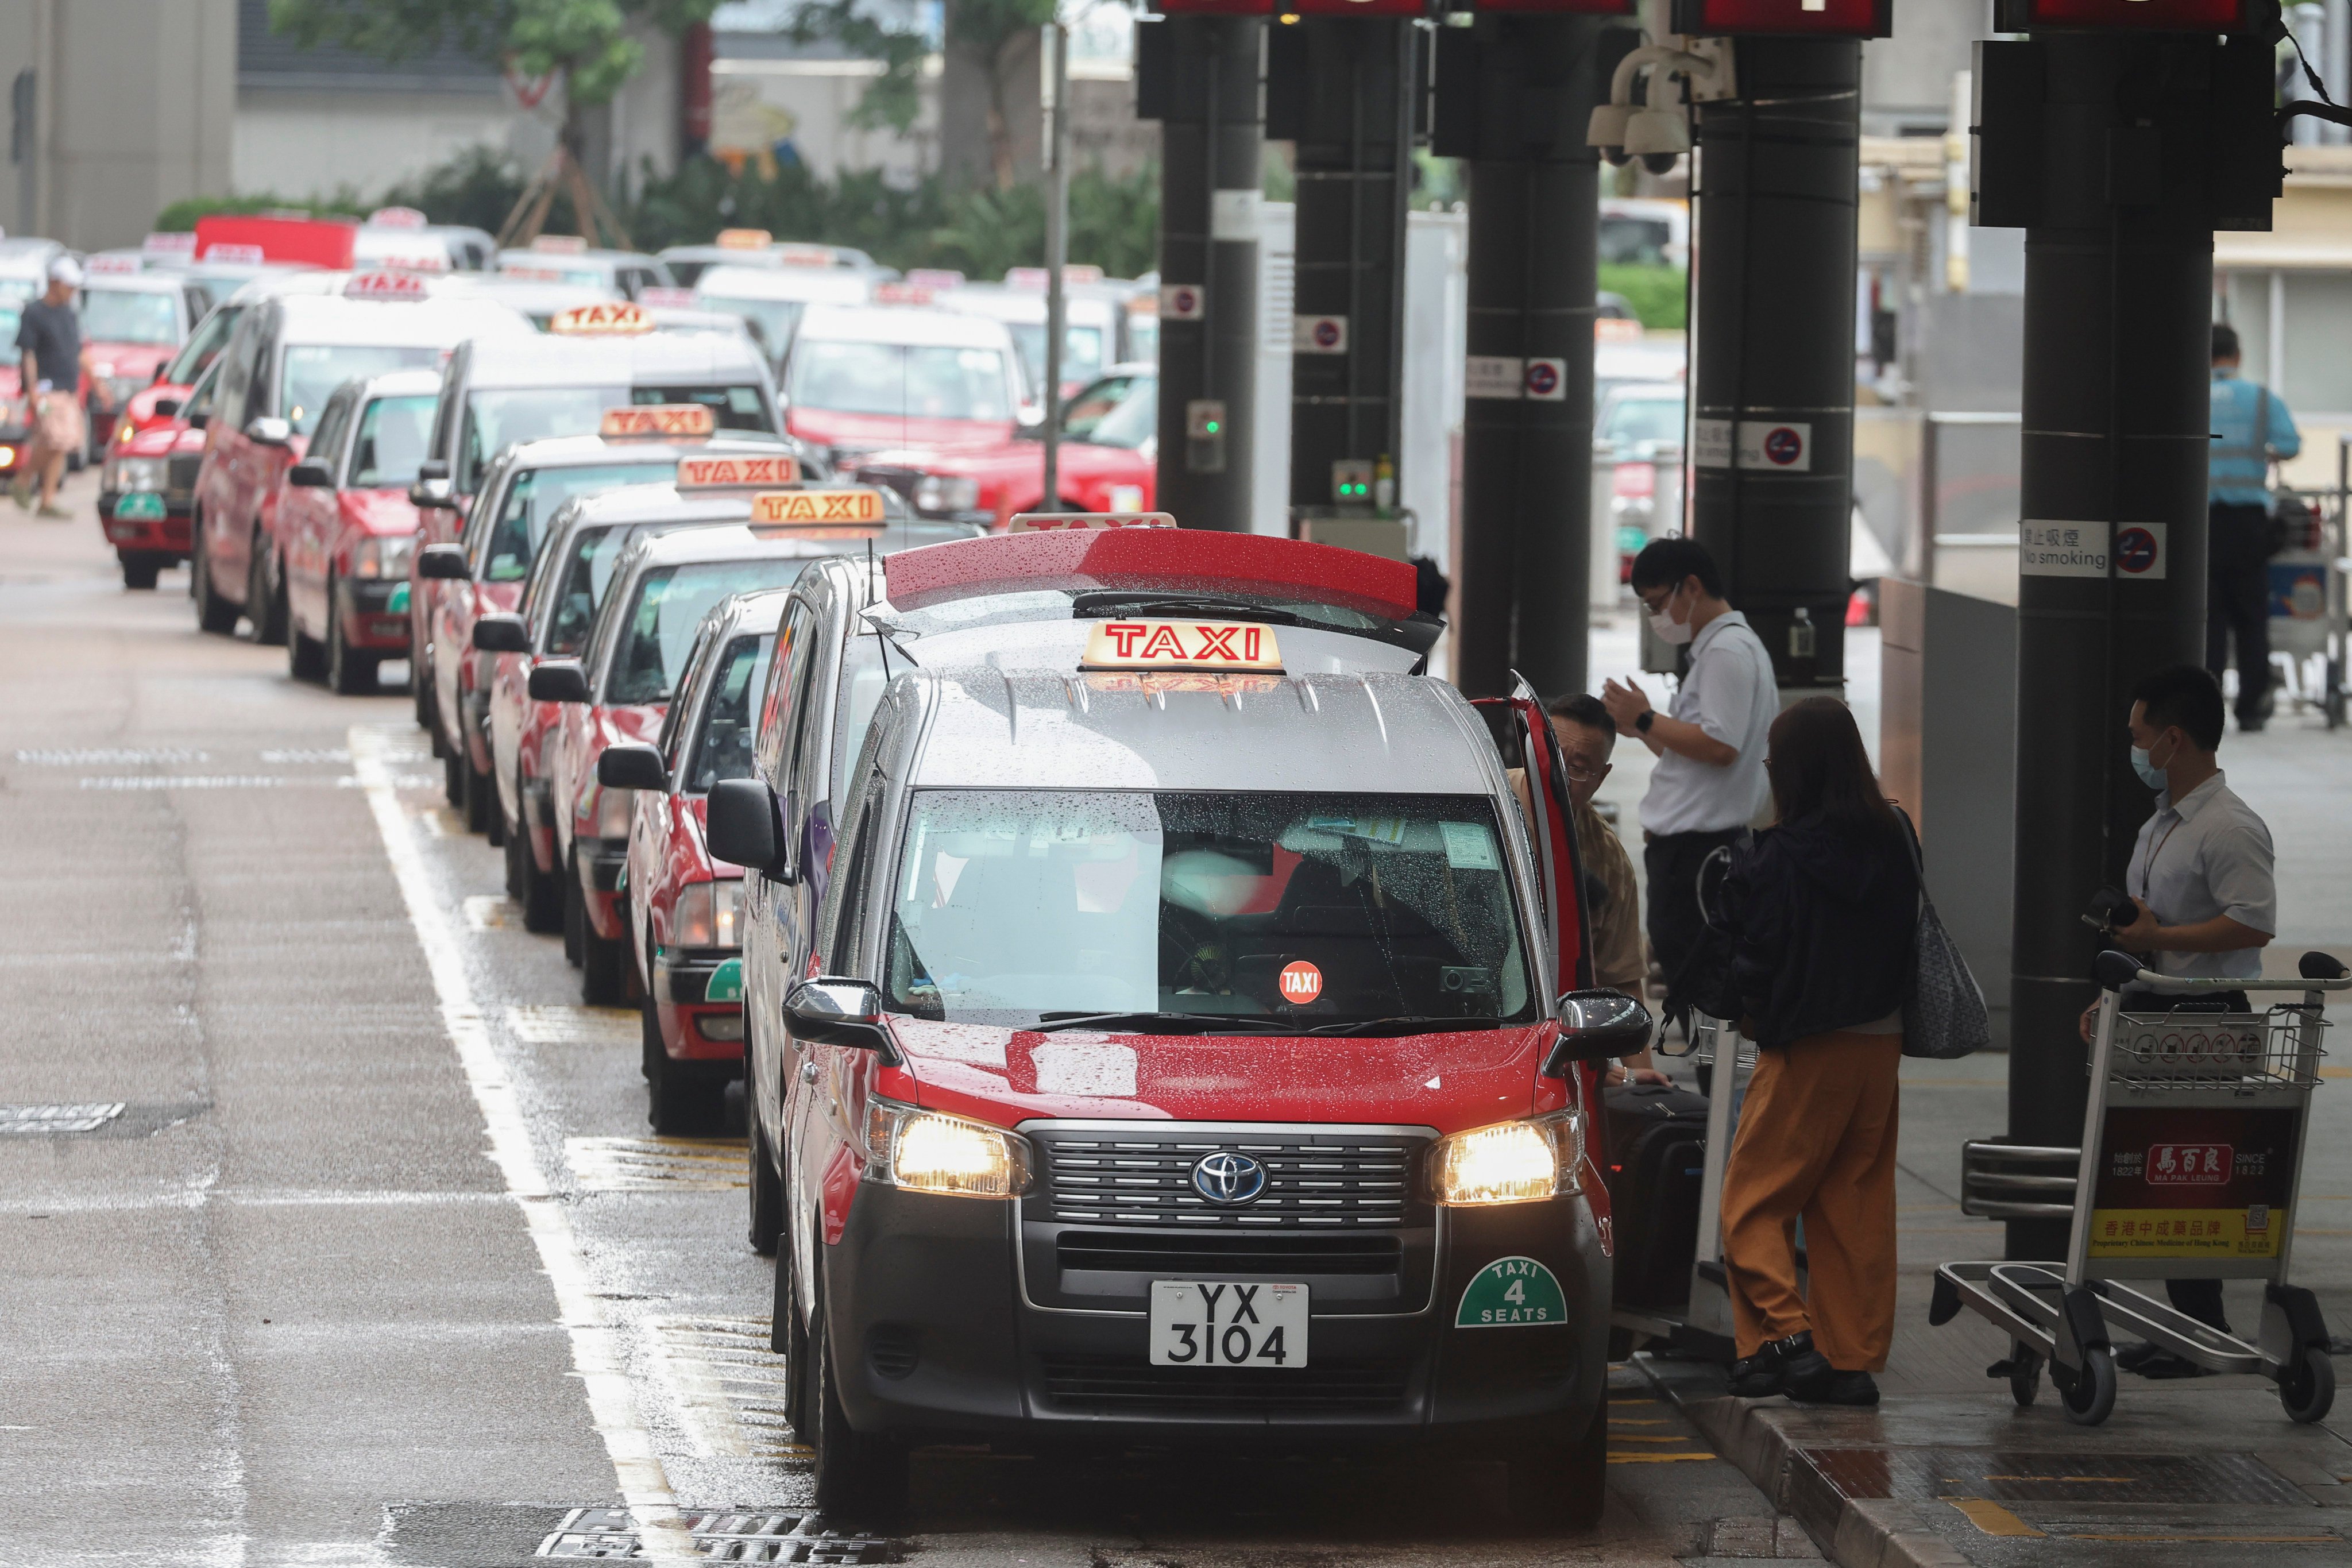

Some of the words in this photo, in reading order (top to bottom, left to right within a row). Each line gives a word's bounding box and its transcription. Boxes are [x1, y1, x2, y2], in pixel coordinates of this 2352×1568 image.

[357, 272, 420, 291] TAXI
[568, 304, 641, 323] TAXI
[611, 411, 702, 431] TAXI
[686, 459, 791, 483] TAXI
[762, 495, 872, 519] TAXI
[2025, 529, 2079, 546] 禁止吸煙
[2025, 549, 2036, 563] No
[2040, 550, 2106, 569] smoking
[1106, 624, 1260, 661] TAXI
[1283, 972, 1318, 992] TAXI
[2114, 1152, 2143, 1164] 始創於
[2157, 1146, 2220, 1173] 馬百良
[2235, 1154, 2265, 1164] SINCE
[2112, 1167, 2142, 1176] 1822年
[2235, 1166, 2264, 1175] 1822
[2105, 1220, 2221, 1236] 香港中成藥品牌
[2092, 1240, 2128, 1248] Proprietary
[1492, 1261, 1538, 1279] TAXI
[1504, 1279, 1525, 1305] 4
[1197, 1284, 1260, 1324] YX
[1481, 1307, 1547, 1322] SEATS
[1168, 1324, 1287, 1365] 3104
